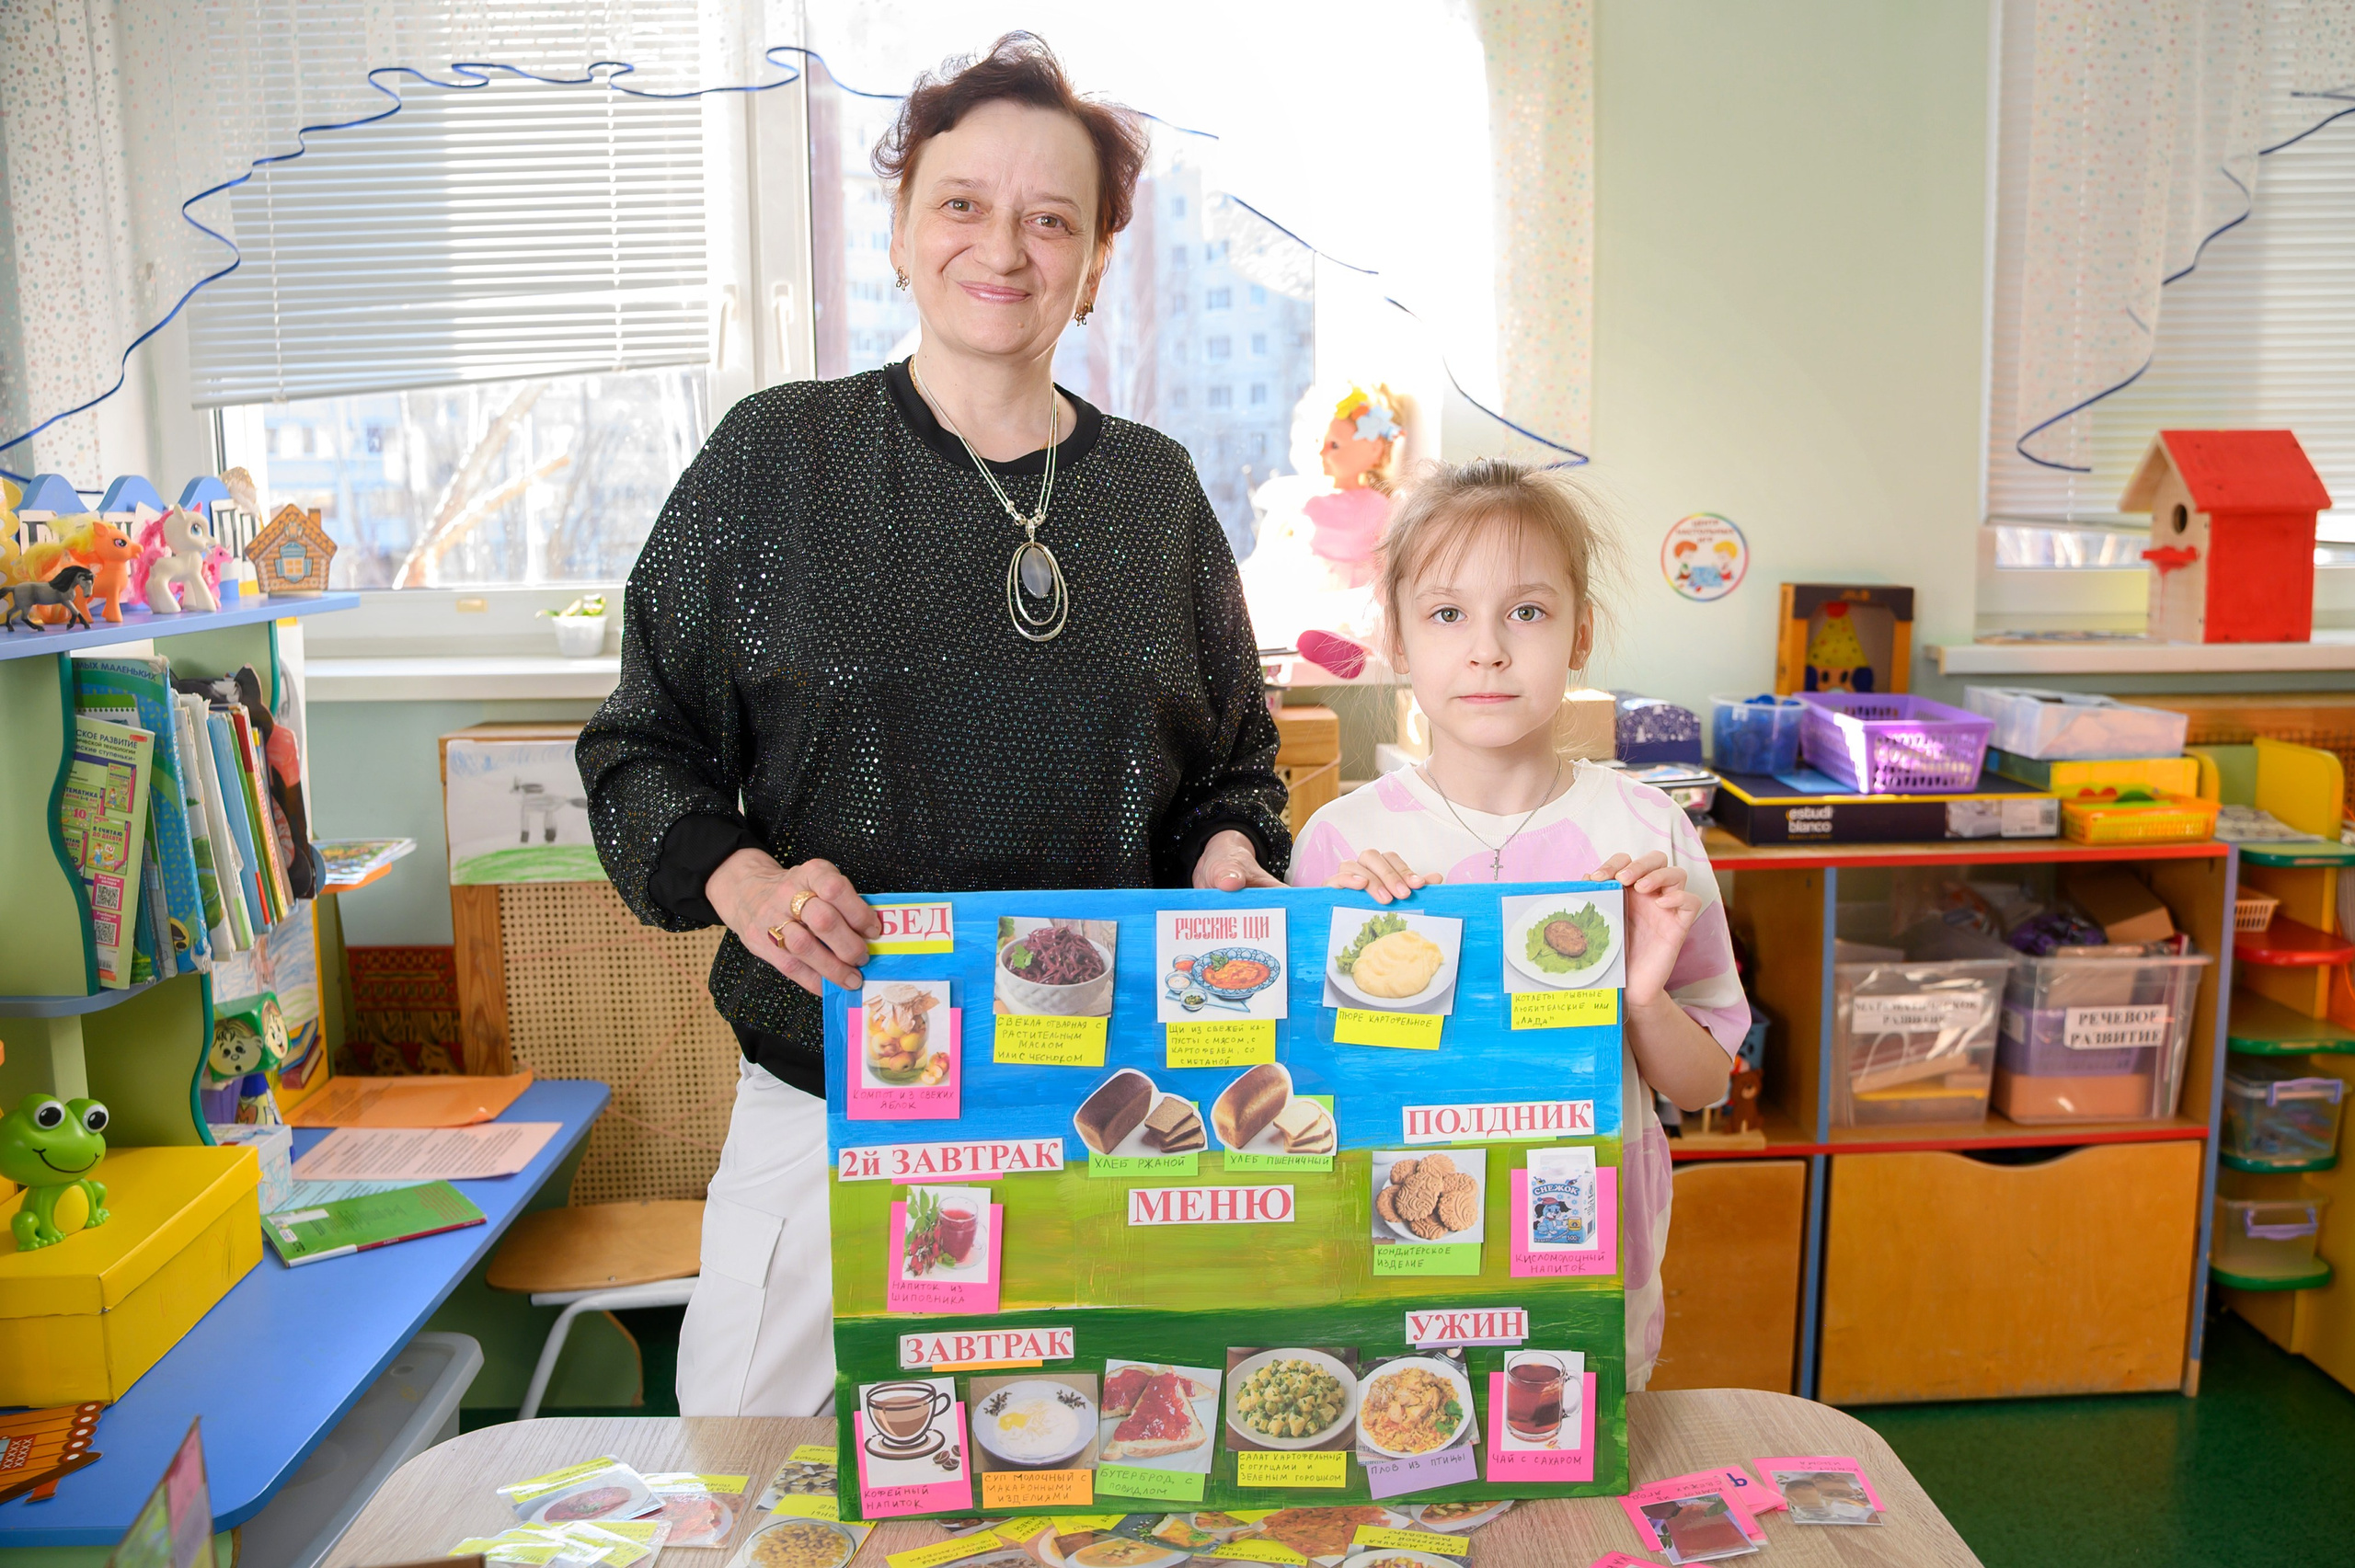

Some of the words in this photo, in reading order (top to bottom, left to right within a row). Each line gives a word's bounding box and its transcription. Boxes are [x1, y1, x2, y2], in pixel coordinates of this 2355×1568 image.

[100, 662, 157, 681] МАЛЕНЬКИХ
[75, 728, 98, 740] СКОЕ
[99, 734, 138, 750] РАЗВИТИЕ
[75, 745, 98, 753] еские
[64, 786, 98, 798] ТЕМАТИКА
[74, 808, 87, 819] 10
[98, 827, 122, 837] СЧИТАЮ
[101, 833, 122, 842] ДЕСЯТИ
[874, 907, 951, 941] БЕД
[1175, 916, 1238, 941] РУССКИЕ
[1243, 916, 1269, 942] ЩИ
[1515, 993, 1555, 1002] КОТЛЕТЫ
[1563, 990, 1603, 999] РЫБНЫЕ
[1513, 1001, 1586, 1013] ЛЮБИТЕЛЬСКИЕ
[1338, 1010, 1363, 1023] ПЮРЕ
[1369, 1014, 1432, 1028] КАРТОФЕЛЬНОЕ
[2078, 1009, 2160, 1026] РЕЧЕВОЕ
[1046, 1020, 1087, 1029] ОТВАРНАЯ
[1191, 1025, 1201, 1035] ИЗ
[1206, 1024, 1244, 1033] СВЕЖЕЙ
[1002, 1029, 1082, 1040] РАСТИТЕЛЬНЫМ
[2070, 1028, 2161, 1046] РАЗВИТИЕ
[1018, 1039, 1063, 1048] МАСЛОМ
[1180, 1056, 1231, 1066] СМЕТАНОЙ
[853, 1089, 894, 1100] КОМПОТ
[900, 1091, 914, 1100] ИЗ
[920, 1091, 955, 1100] СВЕЖИХ
[879, 1100, 916, 1110] ЯБЛОК
[1406, 1103, 1592, 1139] ПОЛДНИК
[842, 1150, 881, 1177] 2й
[891, 1142, 1059, 1174] ЗАВТРАК
[1095, 1158, 1129, 1170] ХЛЕБ
[1137, 1156, 1185, 1170] РЖАНОЙ
[1229, 1154, 1258, 1165] ХЛЕБ
[1266, 1155, 1330, 1166] ПШЕНИЧНЫЙ
[1534, 1184, 1580, 1196] СНЕЖОК
[1132, 1186, 1292, 1223] МЕНЮ
[1377, 1246, 1452, 1257] КОНДИТЕРСКОЕ
[1514, 1251, 1606, 1264] КИСЛОМОЛОЧНЫЙ
[1376, 1258, 1425, 1270] ИЗДЕЛИЕ
[1530, 1263, 1587, 1274] НАПИТОК
[891, 1280, 940, 1291] НАПИТОК
[950, 1285, 963, 1293] ИЗ
[890, 1293, 965, 1305] ШИПОВНИКА
[1408, 1311, 1526, 1341] УЖИН
[905, 1331, 1073, 1364] ЗАВТРАК
[1238, 1453, 1269, 1461] САЛАТ
[1273, 1453, 1343, 1461] КАРТОФЕЛЬНЫЙ
[1491, 1453, 1515, 1464] ЧАЙ
[1534, 1455, 1582, 1466] САХАРОМ
[1248, 1463, 1297, 1471] ОГУРЦАМИ
[1371, 1463, 1399, 1475] ПЛОВ
[1407, 1460, 1421, 1471] ИЗ
[1430, 1453, 1466, 1467] ПТИЦЫ
[984, 1474, 1006, 1482] СУП
[1013, 1472, 1074, 1482] МОЛОЧНЫЙ
[864, 1485, 929, 1499] КОФЕЙНЫЙ
[986, 1483, 1072, 1493] МАКАРОННЫМИ
[1109, 1482, 1167, 1496] ПОВИДЛОМ
[867, 1499, 924, 1510] НАПИТОК
[997, 1493, 1069, 1505] ИЗДЕЛИЯМИ
